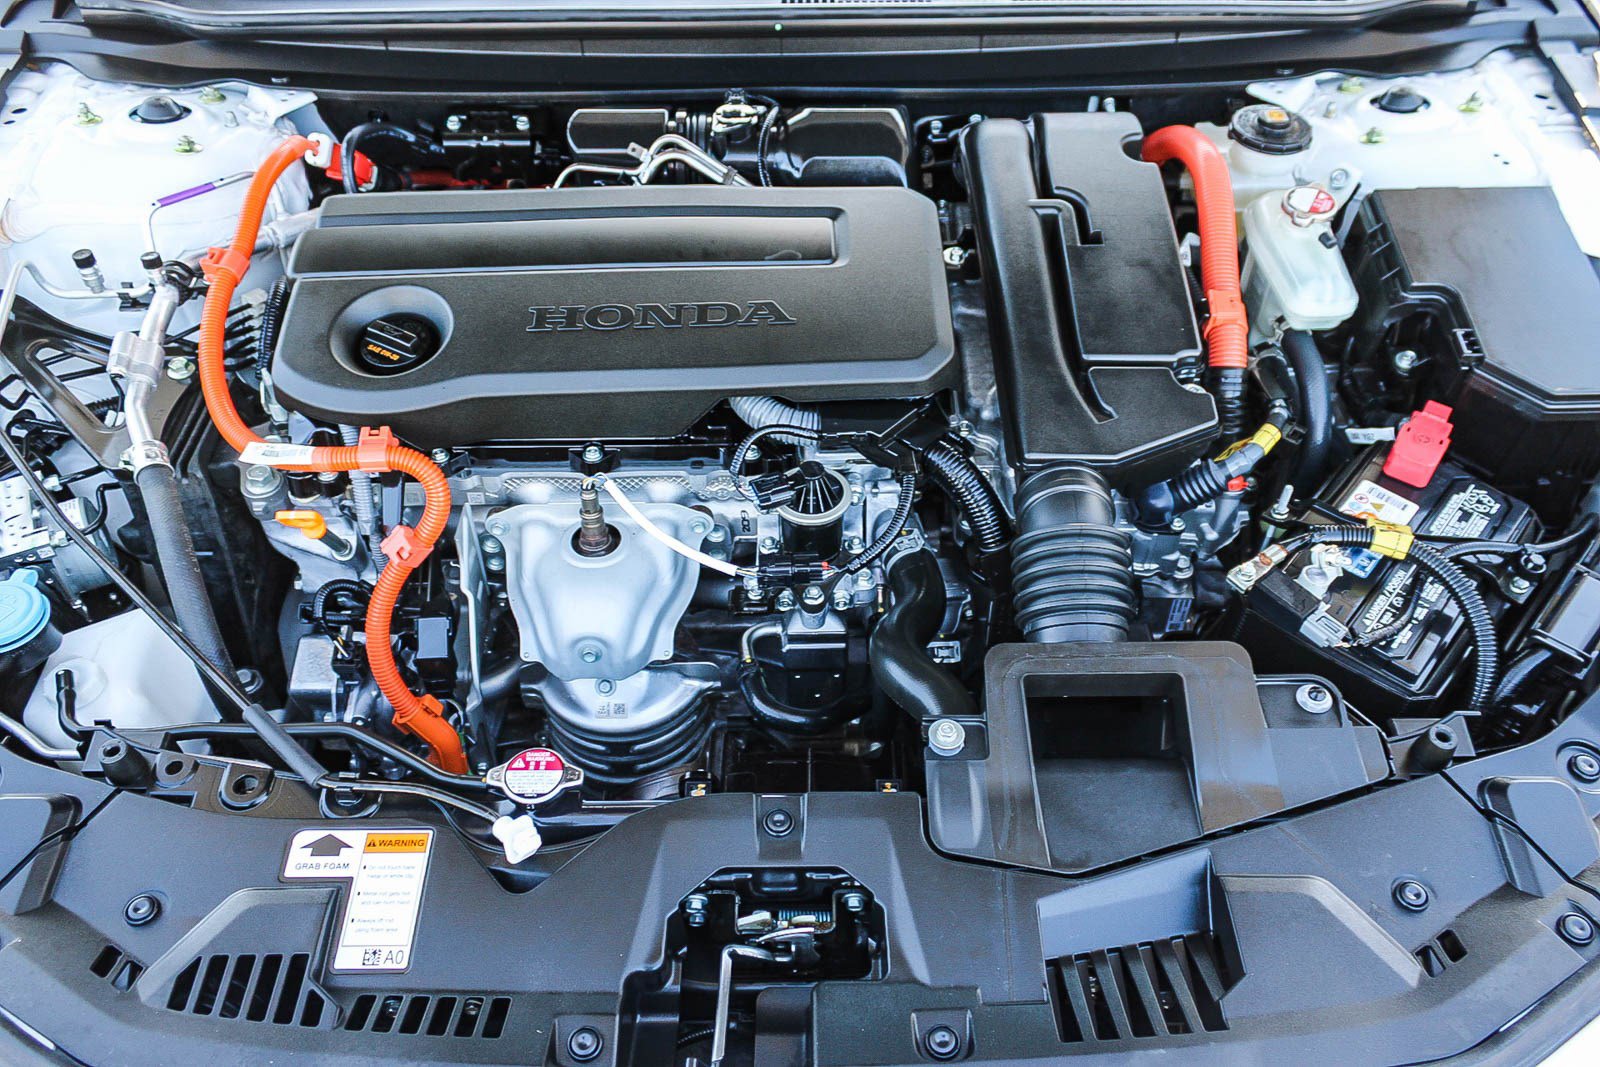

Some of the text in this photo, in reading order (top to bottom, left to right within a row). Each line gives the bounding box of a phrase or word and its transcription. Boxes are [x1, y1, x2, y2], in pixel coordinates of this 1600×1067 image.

[526, 300, 797, 332] HONDA
[378, 839, 425, 848] WARNING
[323, 862, 351, 870] FOAM
[383, 949, 404, 965] A0
